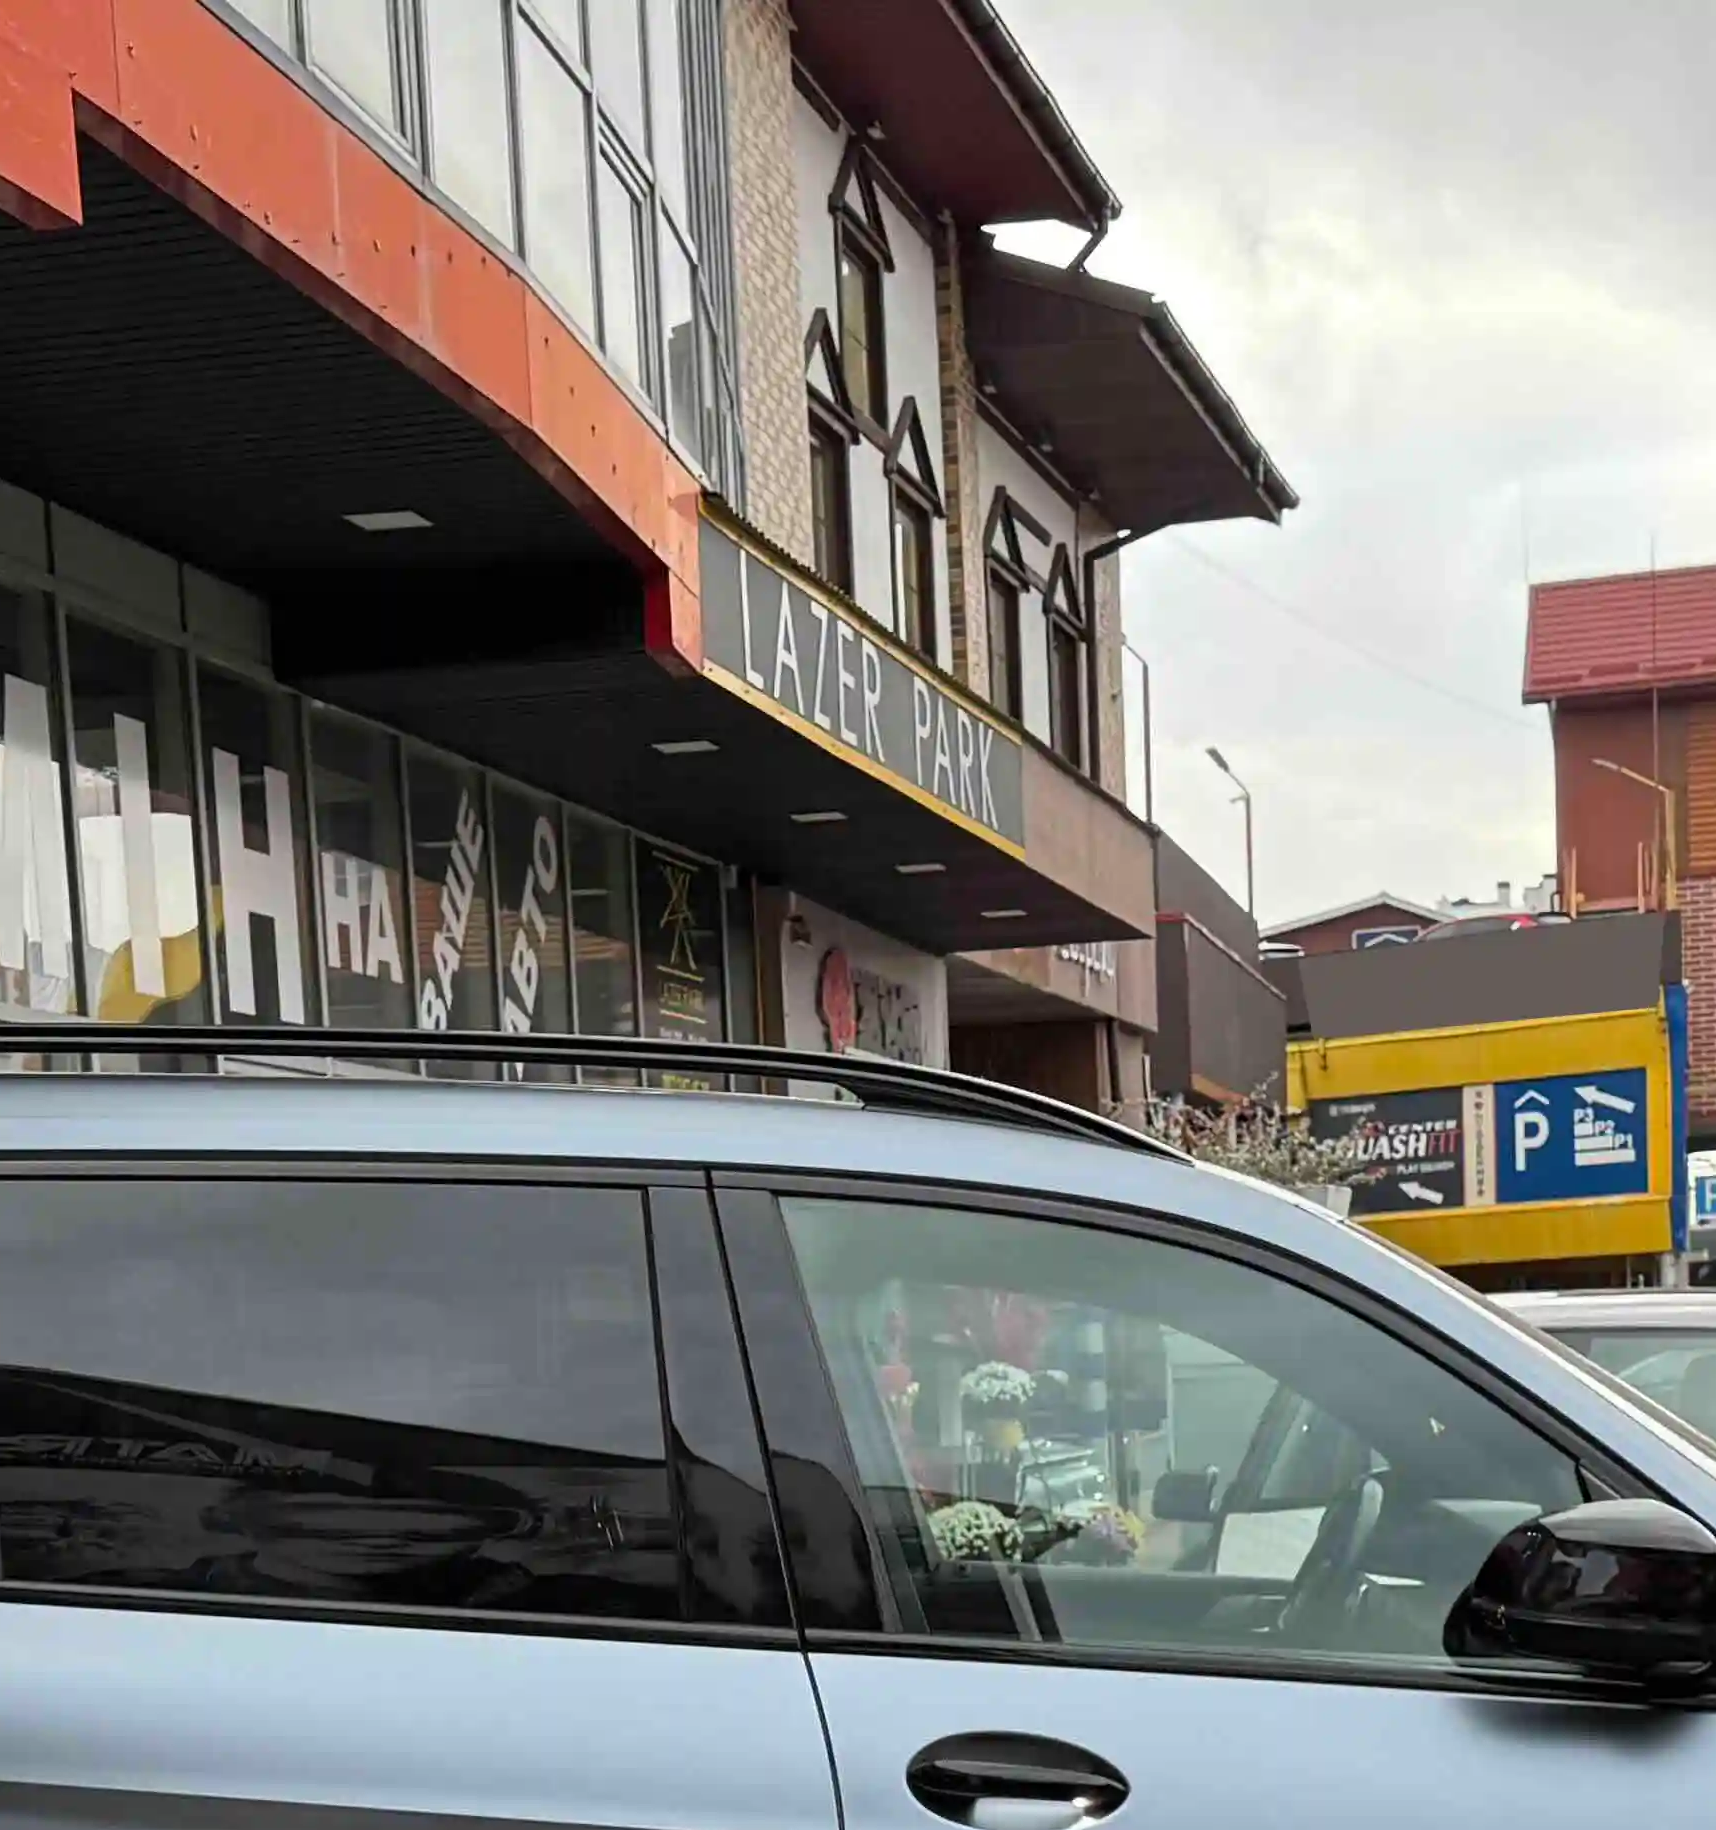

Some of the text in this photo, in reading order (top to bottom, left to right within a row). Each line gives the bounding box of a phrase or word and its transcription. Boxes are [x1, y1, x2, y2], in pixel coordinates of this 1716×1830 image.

[739, 548, 999, 832] LAZER PARK
[321, 850, 405, 985] НА
[420, 787, 484, 1031] ВАШЕ
[1514, 1111, 1550, 1172] P
[1573, 1106, 1594, 1124] P3
[1614, 1132, 1634, 1149] P1
